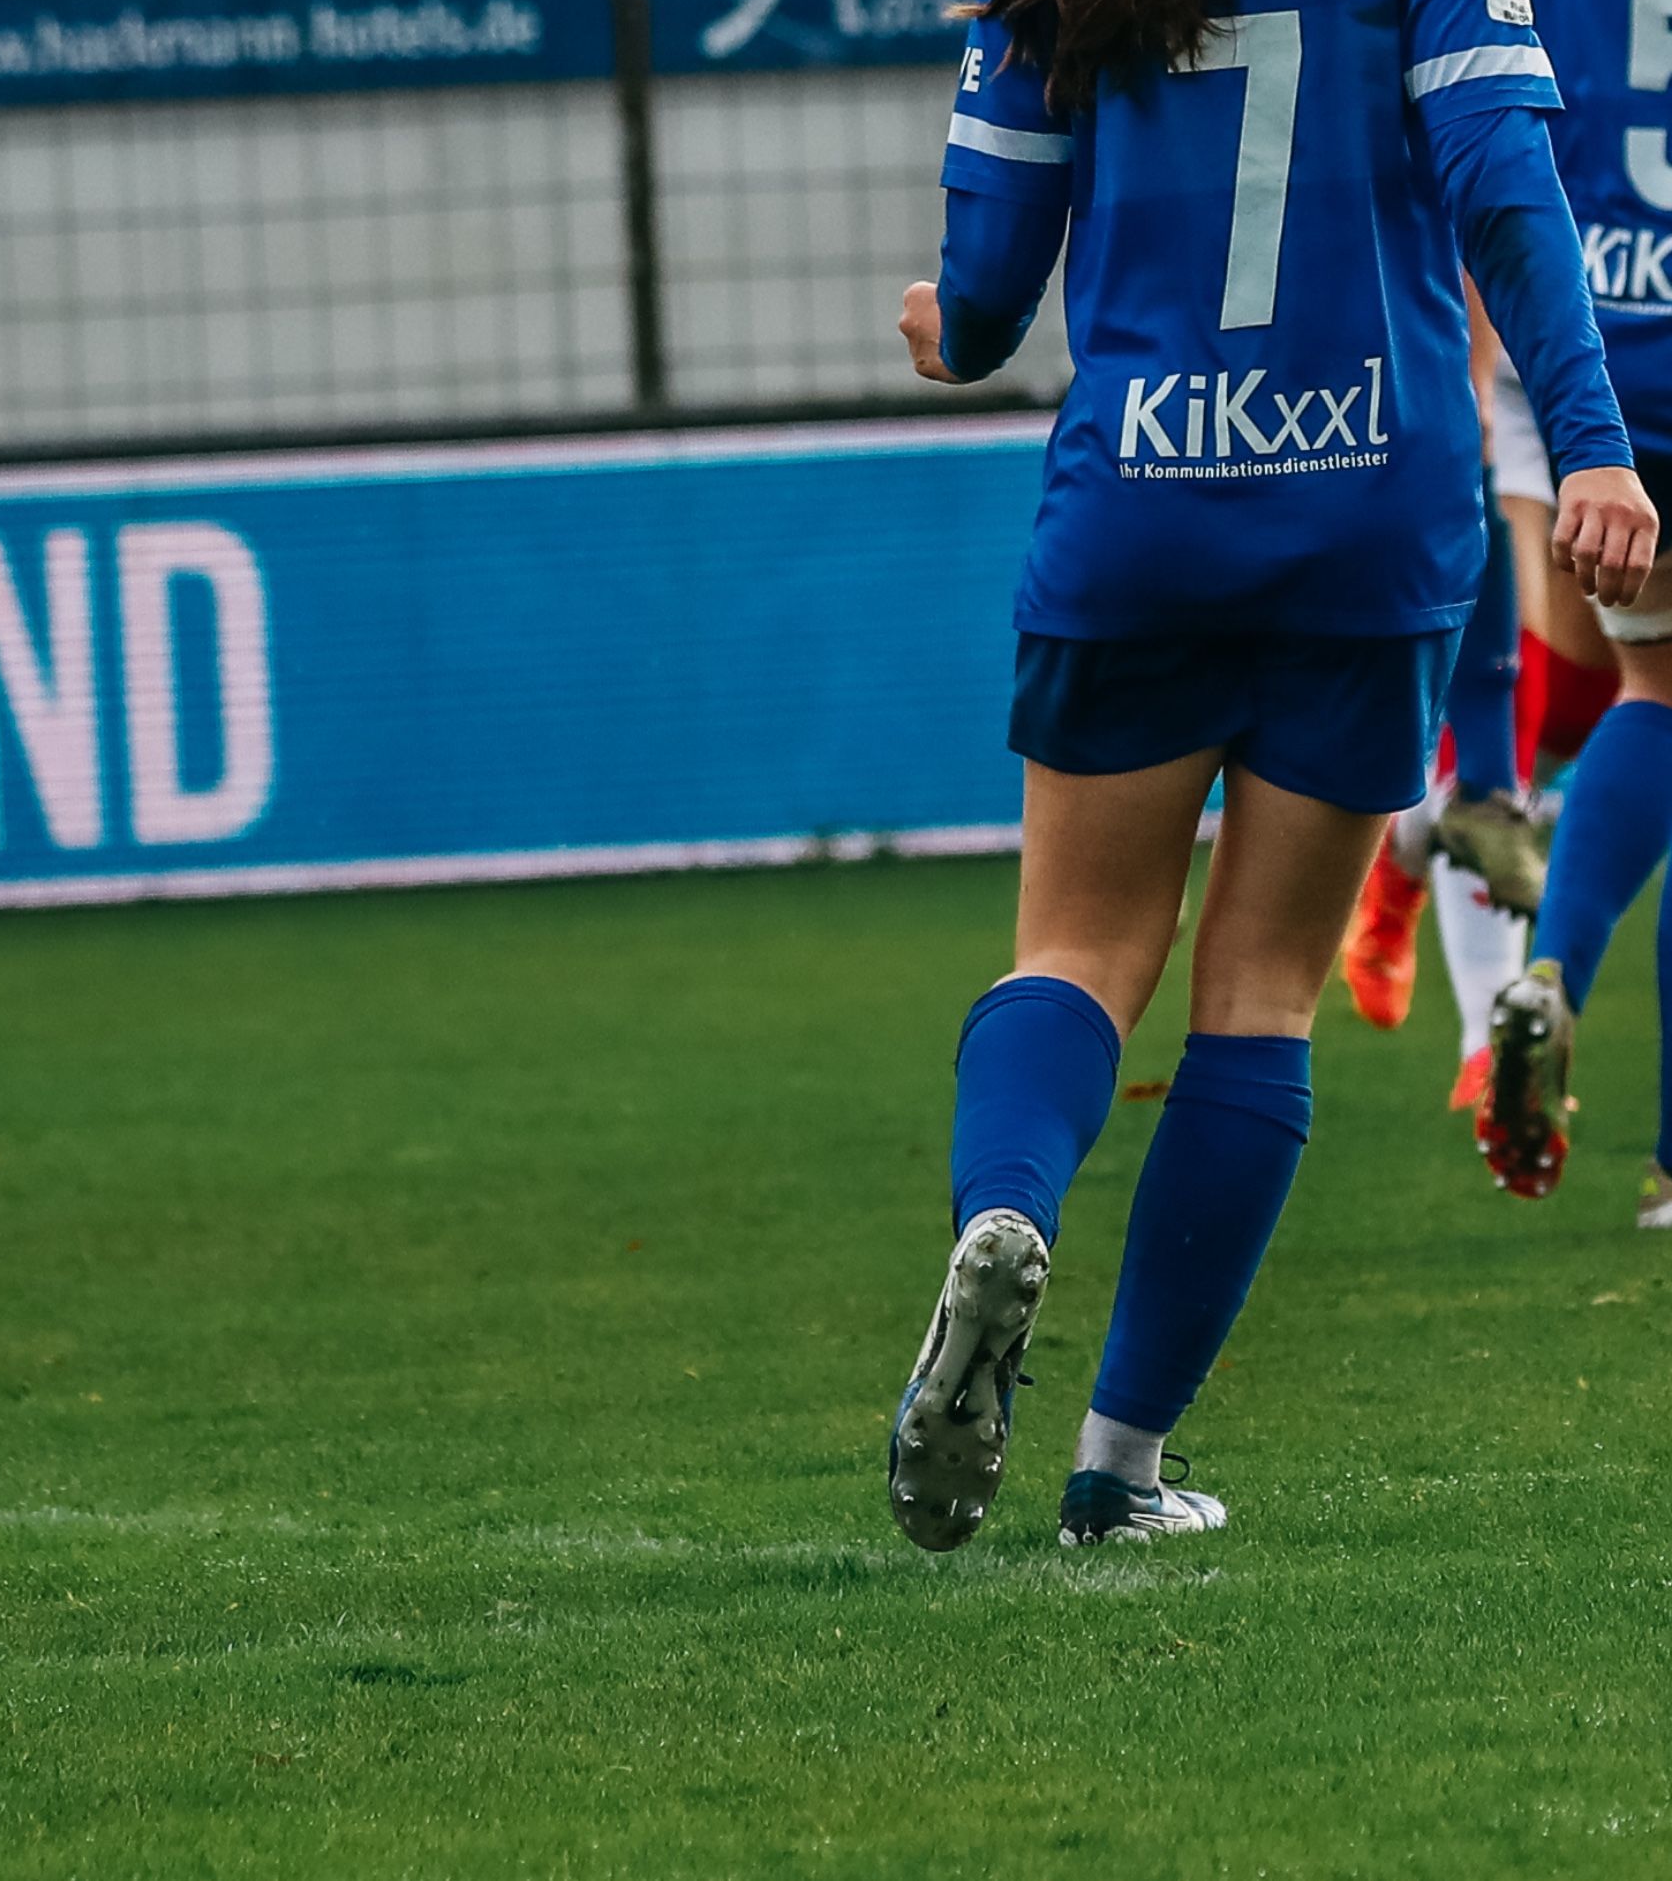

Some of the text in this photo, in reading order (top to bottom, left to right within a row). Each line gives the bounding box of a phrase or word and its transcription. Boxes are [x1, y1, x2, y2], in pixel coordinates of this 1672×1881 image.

[1168, 9, 1303, 331] 7
[1119, 357, 1390, 459] KiKxxl
[1119, 451, 1390, 480] Ihr Kommunikationsdienstleister
